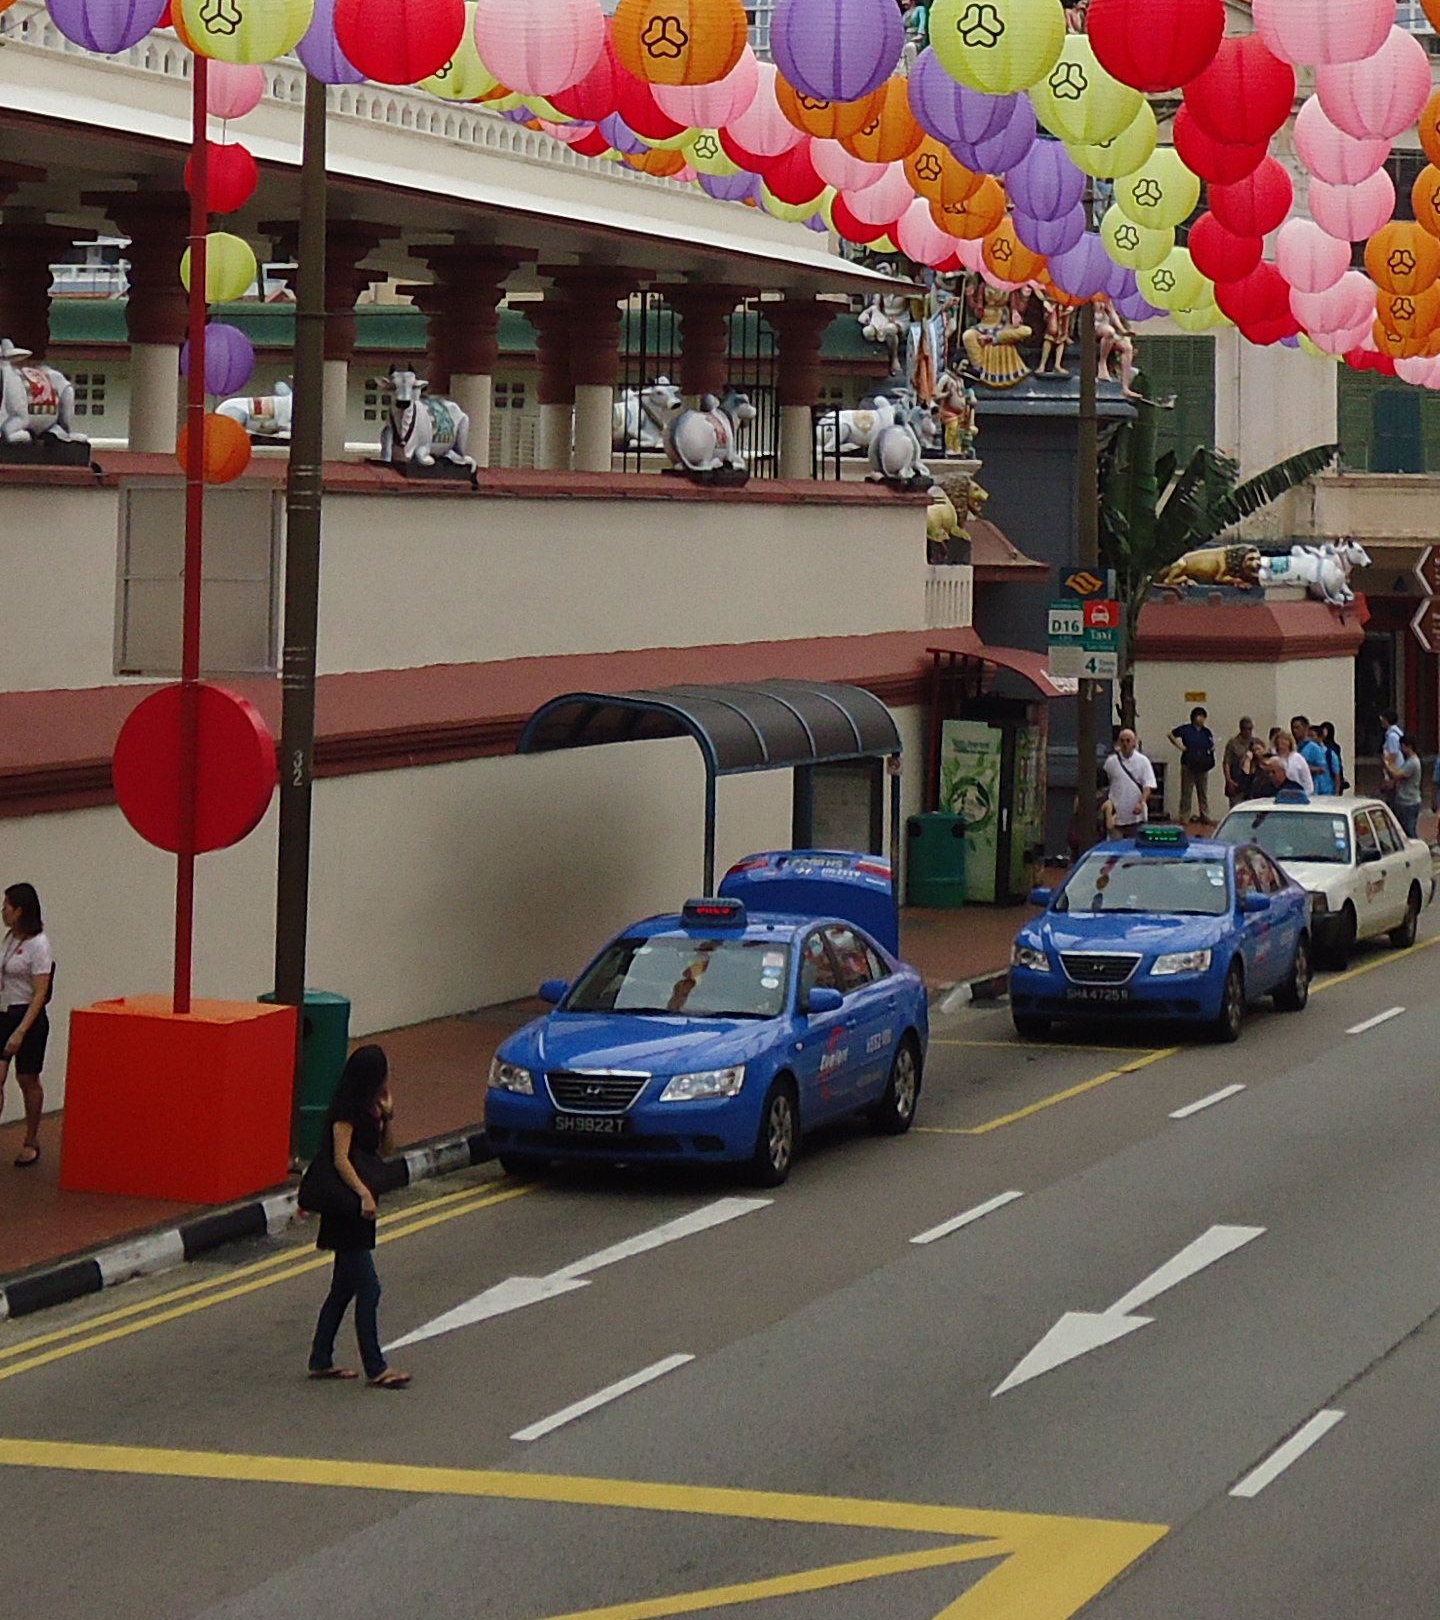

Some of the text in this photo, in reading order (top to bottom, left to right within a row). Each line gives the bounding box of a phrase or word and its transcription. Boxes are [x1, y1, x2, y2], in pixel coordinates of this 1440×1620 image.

[1052, 620, 1080, 632] D16
[1090, 629, 1112, 640] Taxi
[1085, 657, 1097, 674] 4
[292, 749, 303, 786] 32
